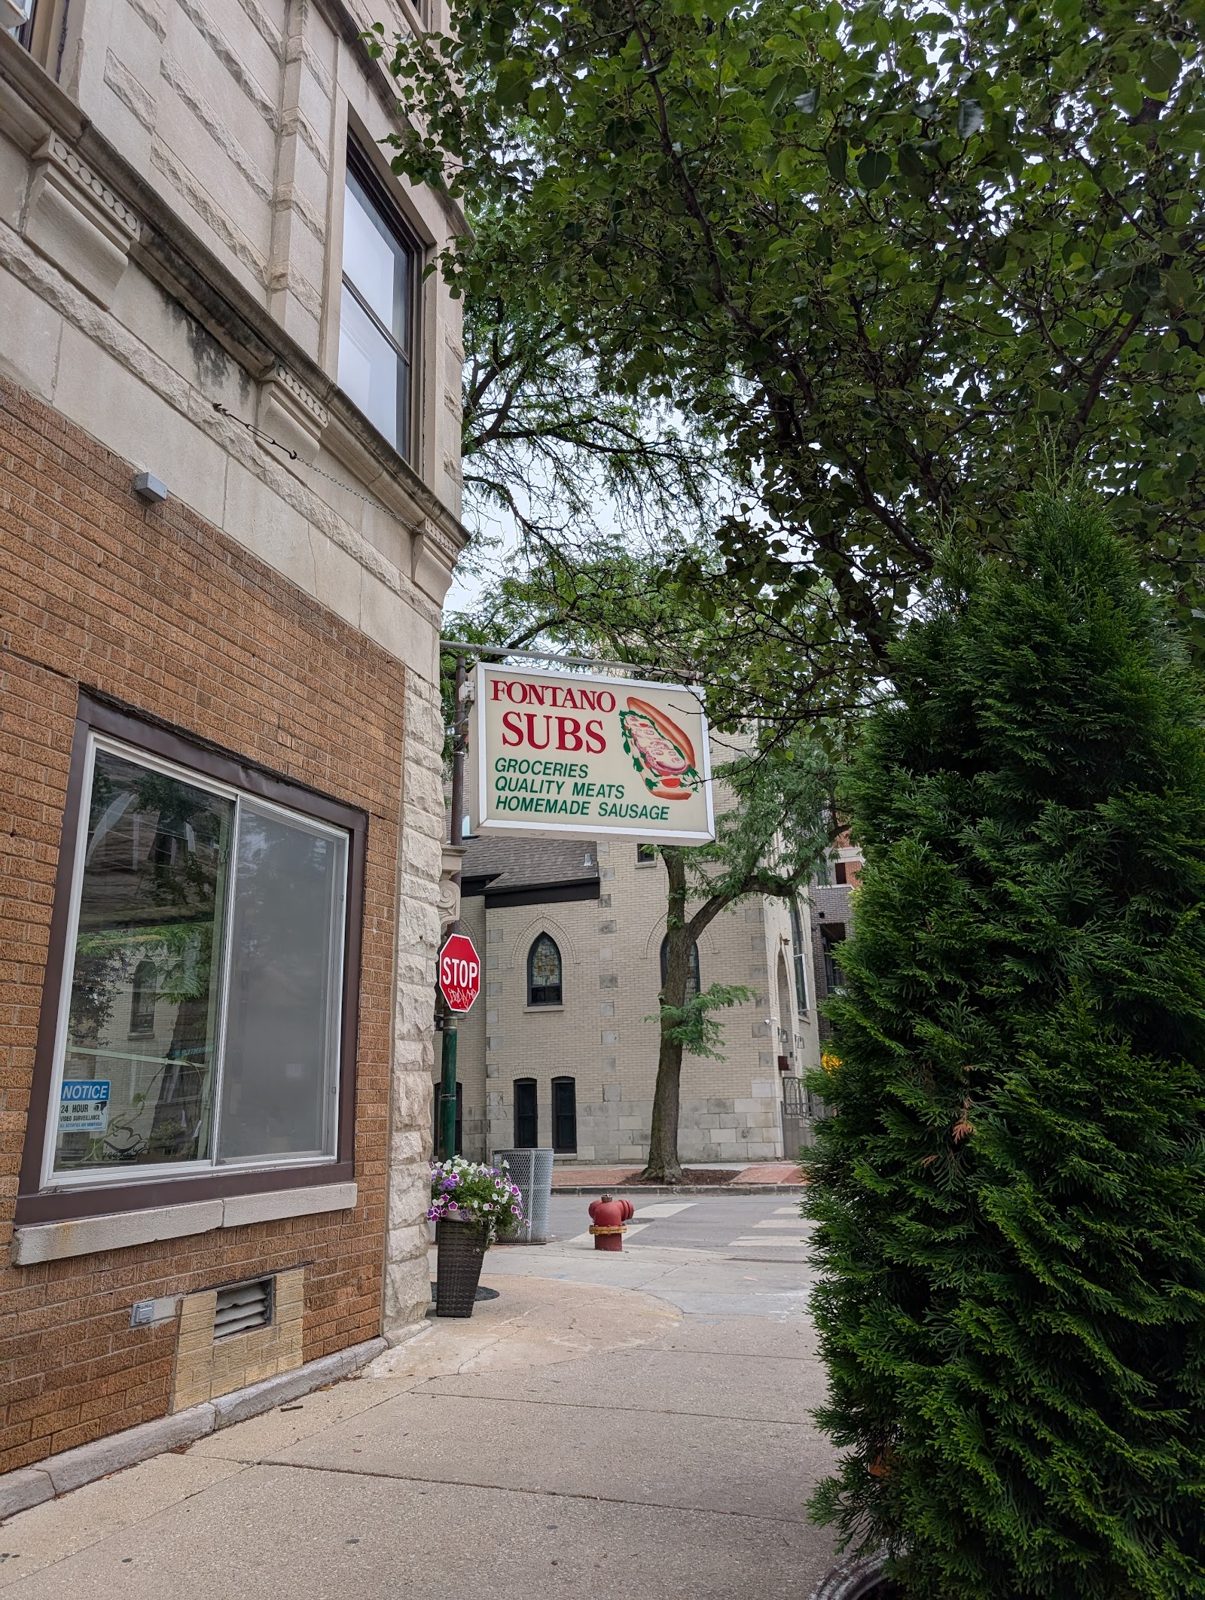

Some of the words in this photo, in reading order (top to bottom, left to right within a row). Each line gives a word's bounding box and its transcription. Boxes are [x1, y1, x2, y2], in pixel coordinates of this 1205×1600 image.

[490, 680, 616, 713] FONTANO
[502, 711, 606, 754] SUBS
[495, 757, 589, 779] GROCERIES
[495, 776, 565, 795] QUALITY
[572, 782, 625, 800] MEATS
[496, 795, 591, 816] HOMEMADE
[598, 802, 670, 821] SAUSAGE
[443, 957, 478, 989] STOP
[62, 1085, 108, 1099] NOTICE
[60, 1105, 69, 1113] 24
[72, 1104, 89, 1113] HOUR
